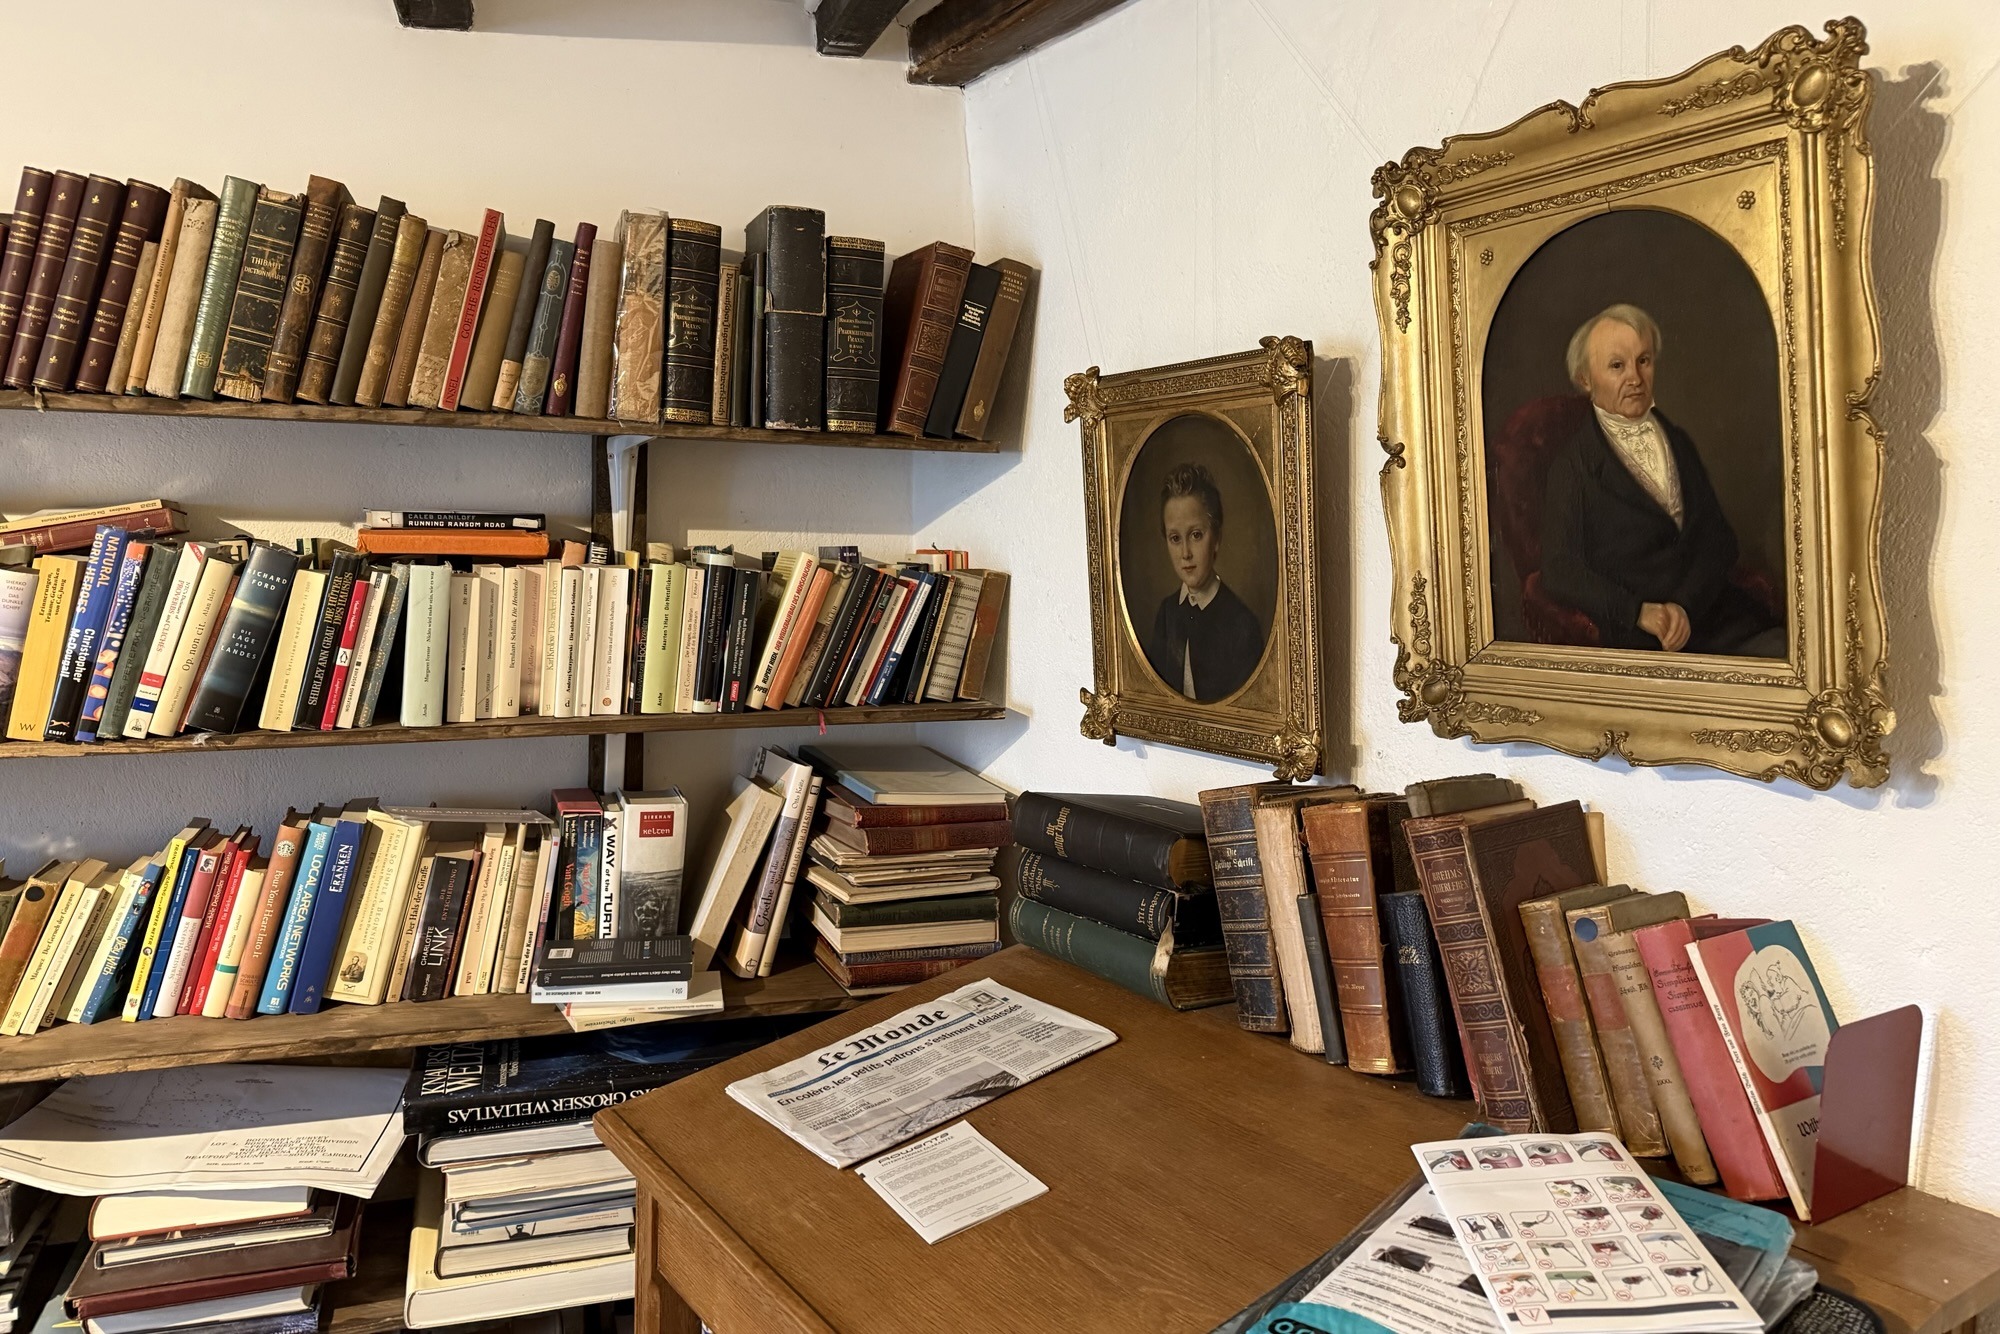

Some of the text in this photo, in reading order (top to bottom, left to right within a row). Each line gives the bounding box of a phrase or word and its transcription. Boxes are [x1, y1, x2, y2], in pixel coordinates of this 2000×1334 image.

[460, 214, 498, 340] GOETHE REINEKE FUCHS
[445, 376, 459, 404] INSEL
[76, 533, 104, 614] BORN HEROES
[97, 535, 120, 588] NATURAL
[247, 568, 288, 586] RICHARD
[796, 558, 814, 596] MENSCHLICHEN
[251, 579, 276, 591] FORD
[332, 572, 354, 626] DES HAUSES
[232, 633, 256, 644] LAGE
[308, 575, 344, 706] SHIRLEY ANN GRAU DIE HÜTER
[779, 604, 797, 642] WIEDERAUFBAU
[60, 628, 80, 678] McDougall
[72, 628, 96, 683] Christopher
[220, 645, 257, 660] LANDES
[770, 650, 779, 667] RIEDL
[774, 640, 784, 652] DER
[762, 663, 774, 684] RUPERT
[392, 853, 398, 866] SO
[606, 834, 616, 868] WAY
[775, 821, 797, 886] Naturwissenschaften
[790, 805, 814, 878] RUSTIC REVISITED
[1226, 848, 1238, 856] Die
[329, 844, 351, 893] FRANKEN
[384, 869, 394, 898] SIMPLE
[416, 865, 429, 890] Giraffe
[606, 868, 610, 878] of
[1233, 858, 1256, 869] Schrift.
[1432, 868, 1463, 882] BREHMS
[205, 906, 216, 929] Michèle
[212, 878, 224, 906] Desbordes
[225, 850, 233, 864] Bitte
[413, 890, 422, 904] der
[441, 868, 458, 921] ENTSCHEIDUNG
[560, 862, 575, 908] Van Gogh
[756, 888, 775, 928] Goethe
[770, 868, 778, 884] und
[253, 870, 285, 958] Pour Your Heart Into It
[276, 854, 324, 992] LOCAL AREA NETWORKS
[367, 906, 384, 951] BEGINNING
[406, 921, 414, 936] Der
[409, 903, 418, 922] Hals
[602, 892, 614, 939] TURTL
[30, 893, 76, 982] Márquez Der Geruch der Guayave
[168, 920, 190, 982] SEBASTIAN HAFFNER
[420, 926, 434, 966] CHARLOTTE
[427, 926, 450, 966] LINK
[170, 964, 182, 998] Geschichte
[184, 922, 197, 951] Deutschen
[1666, 988, 1698, 1001] Simpli-
[1668, 1000, 1704, 1014] cissimus
[776, 1098, 795, 1107] En
[795, 1084, 836, 1102] colère,
[832, 1074, 852, 1088] les
[851, 1062, 885, 1080] petits
[884, 1044, 926, 1067] patrons
[924, 1020, 980, 1050] s'estiment
[976, 1002, 1023, 1026] délaissés
[816, 1009, 950, 1072] Le Monde
[420, 1054, 448, 1096] KNAURS
[448, 1098, 550, 1124] WELTATLAS
[551, 1090, 627, 1113] GROSSER
[882, 1135, 954, 1168] INTERNATIONAL GUARANTEE
